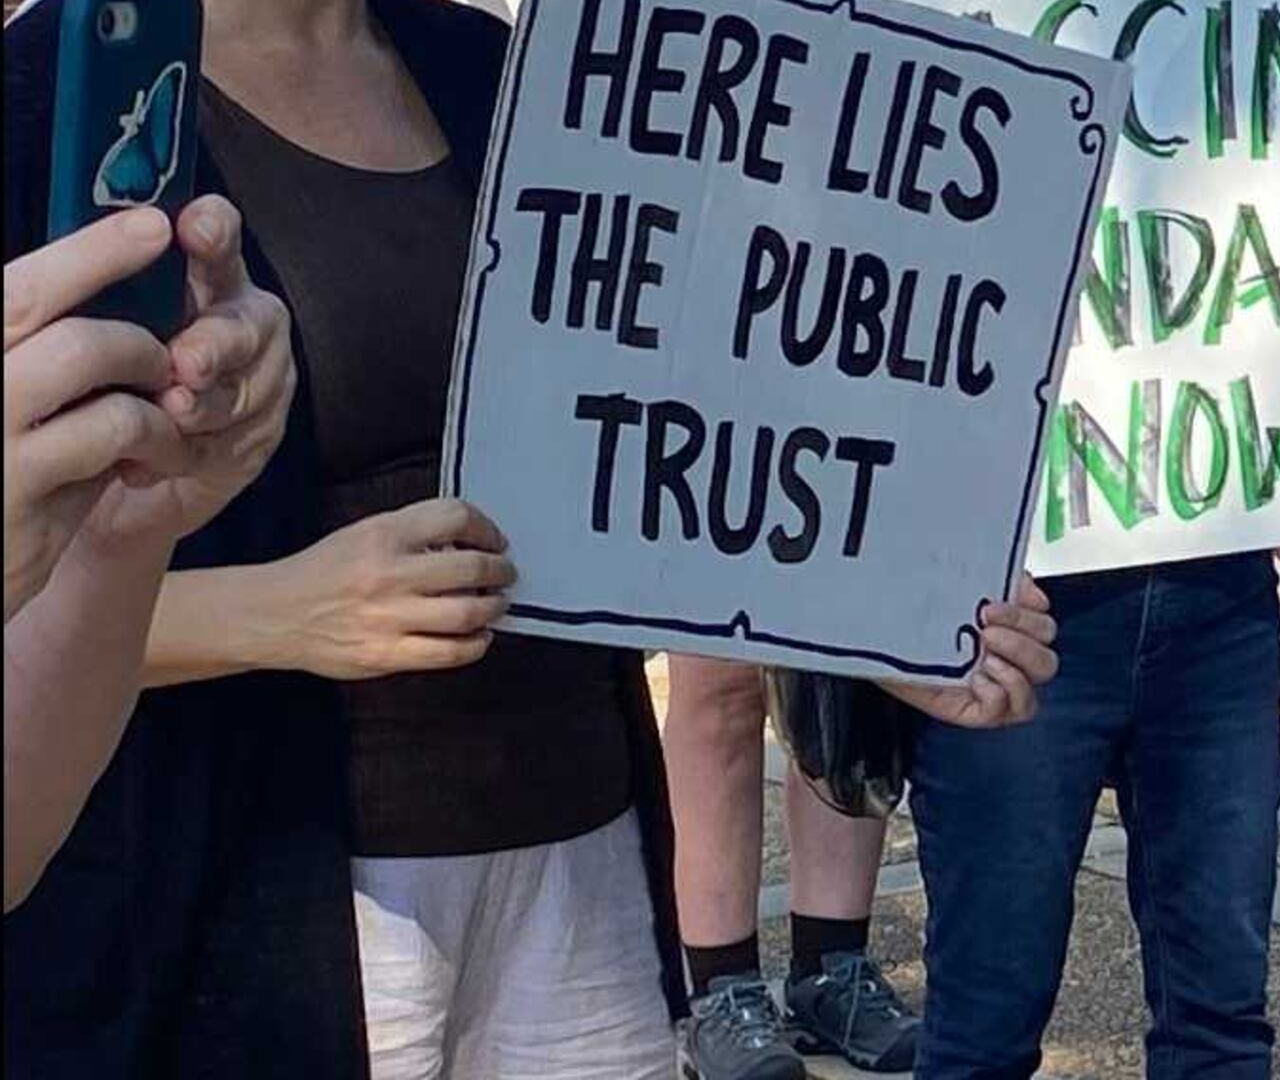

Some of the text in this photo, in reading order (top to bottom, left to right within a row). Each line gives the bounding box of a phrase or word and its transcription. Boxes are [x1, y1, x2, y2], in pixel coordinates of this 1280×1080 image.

[826, 51, 1013, 223] LIES
[515, 186, 1007, 397] THE PUBLIC
[574, 391, 896, 565] TRUST
